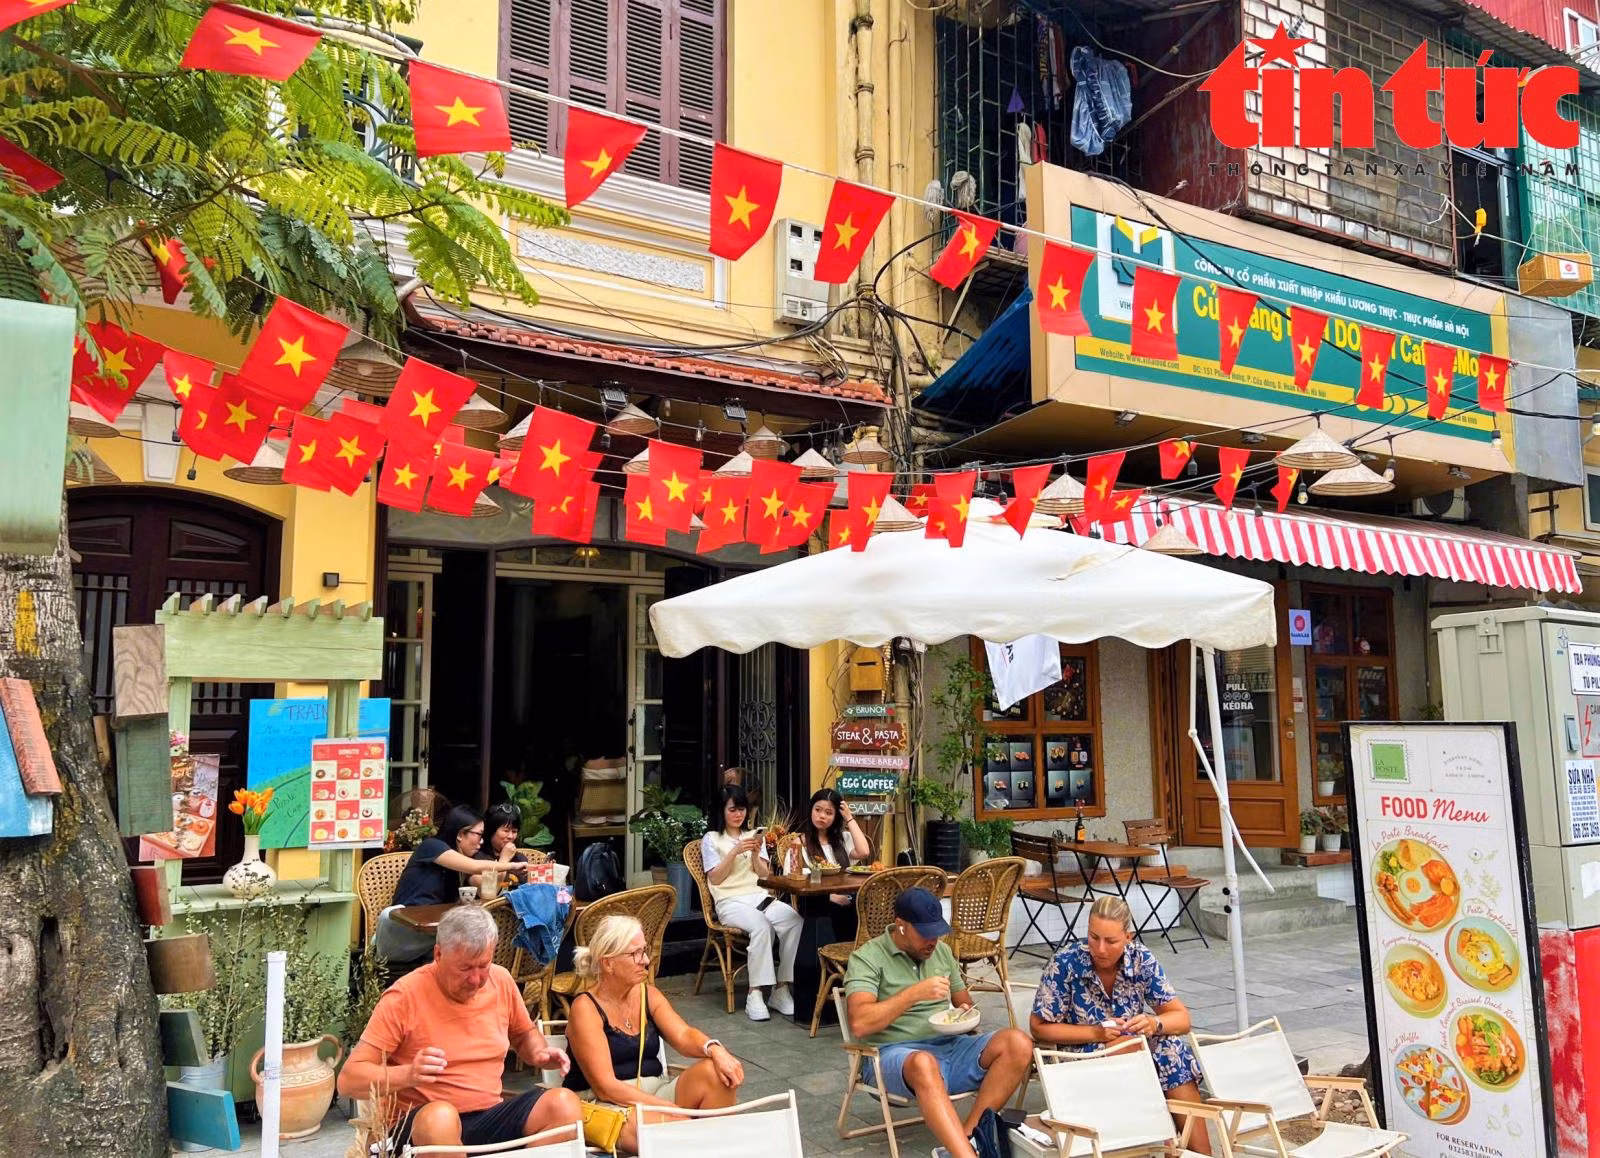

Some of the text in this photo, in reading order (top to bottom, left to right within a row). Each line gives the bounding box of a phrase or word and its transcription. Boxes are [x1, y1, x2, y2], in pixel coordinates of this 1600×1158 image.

[1194, 258, 1222, 275] CÔNG
[1236, 266, 1250, 282] CỔ
[1277, 280, 1299, 294] XUẤT
[1300, 286, 1323, 302] NHẬP
[1325, 289, 1347, 306] KHẨU
[1348, 297, 1377, 314] LƯƠNG
[1378, 305, 1397, 321] THỰC
[1402, 311, 1422, 327] THỰC
[1423, 314, 1443, 330] PHẨM
[1455, 323, 1470, 339] NỘI
[1226, 683, 1248, 691] PULL
[856, 705, 886, 714] BRUNCH
[837, 728, 899, 745] STEAK & PASTA
[835, 756, 903, 767] VIETNAMESE BREAD
[1375, 765, 1399, 773] POSTE
[842, 778, 894, 789] EGG COFFEE
[848, 803, 887, 814] SALAD
[1380, 796, 1490, 823] FOOD Menu
[1381, 826, 1402, 843] Poste
[1404, 825, 1450, 852] Breakfast
[1436, 1132, 1503, 1157] FOR RESERVATION
